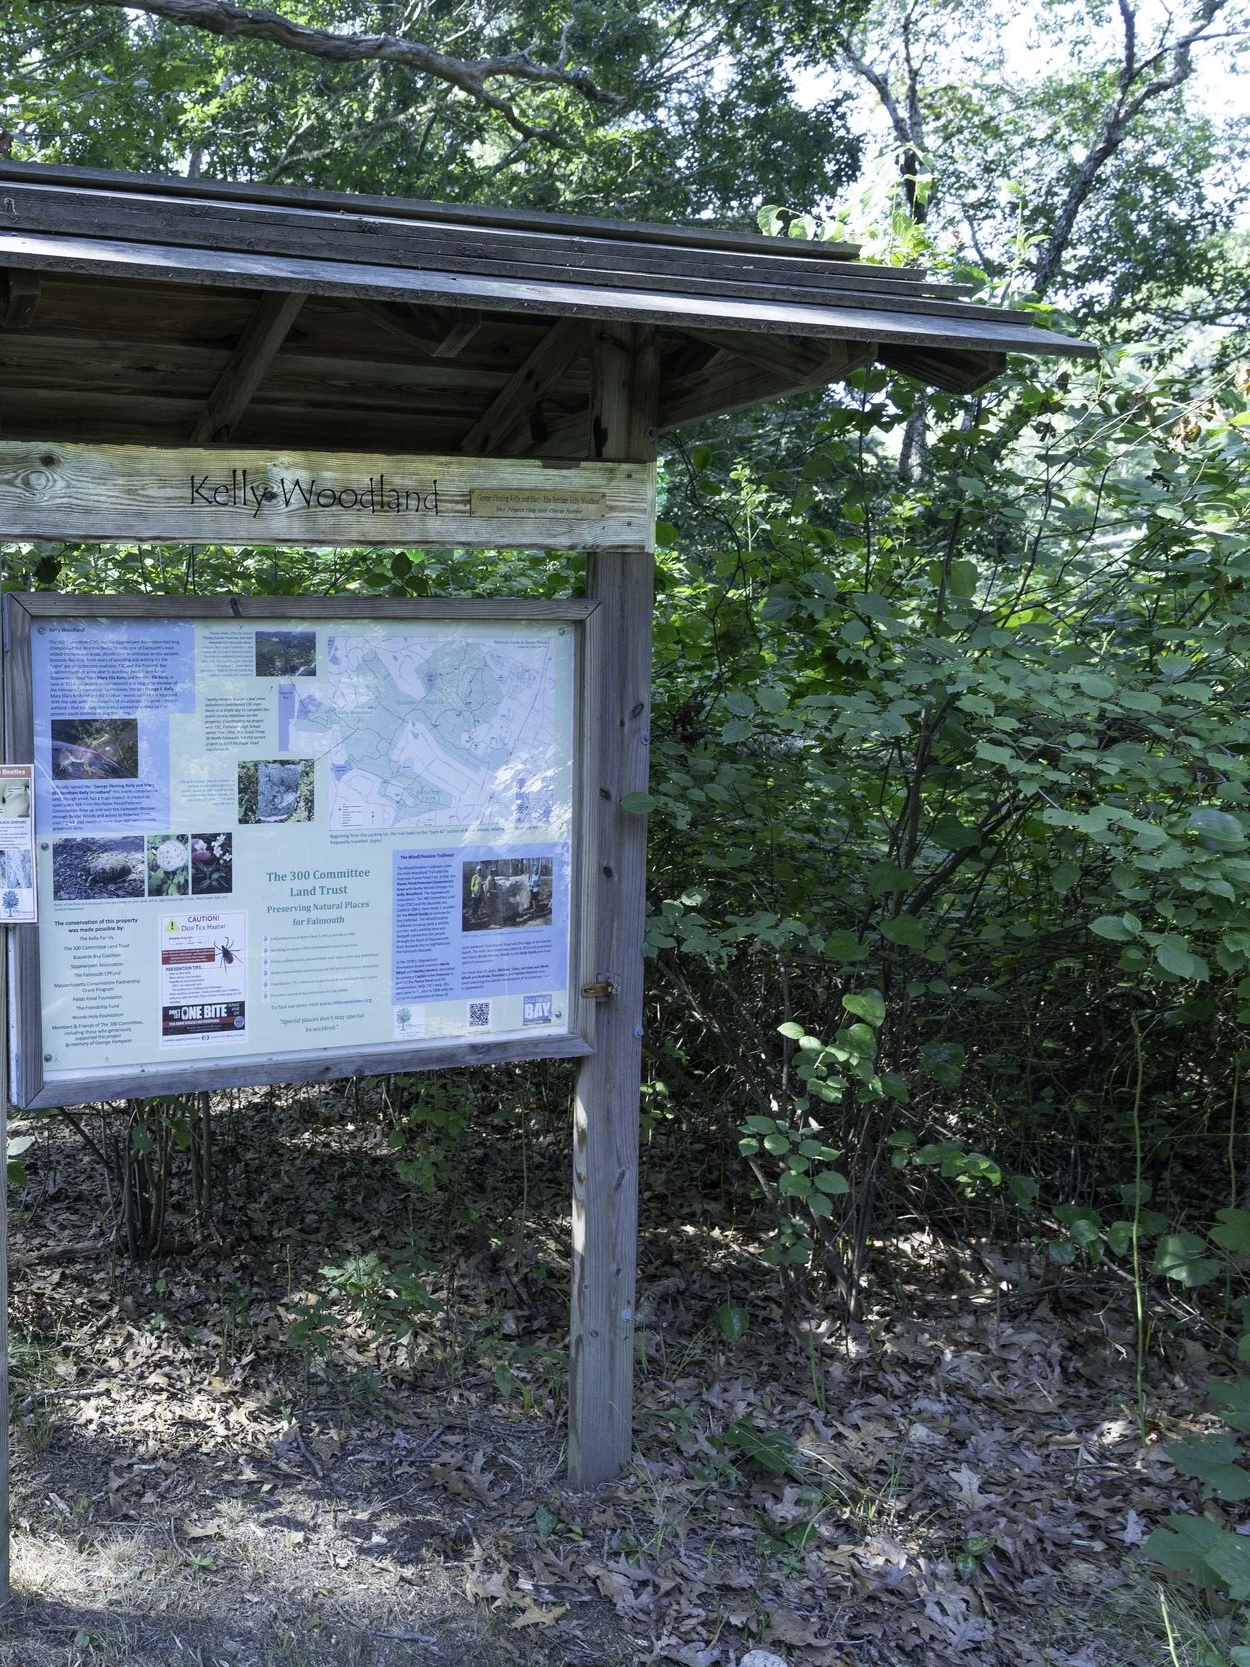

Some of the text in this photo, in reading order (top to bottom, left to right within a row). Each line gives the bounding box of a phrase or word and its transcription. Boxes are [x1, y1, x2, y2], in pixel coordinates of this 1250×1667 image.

[189, 469, 439, 518] Kelly Woodland
[266, 869, 370, 882] The 300 Committee
[290, 885, 348, 896] Land Trust
[267, 901, 370, 913] Preserving Natural Places
[306, 916, 344, 925] Falmouth
[181, 1006, 202, 1020] ONE
[204, 1004, 227, 1019] BITE
[525, 1002, 550, 1019] BAY
